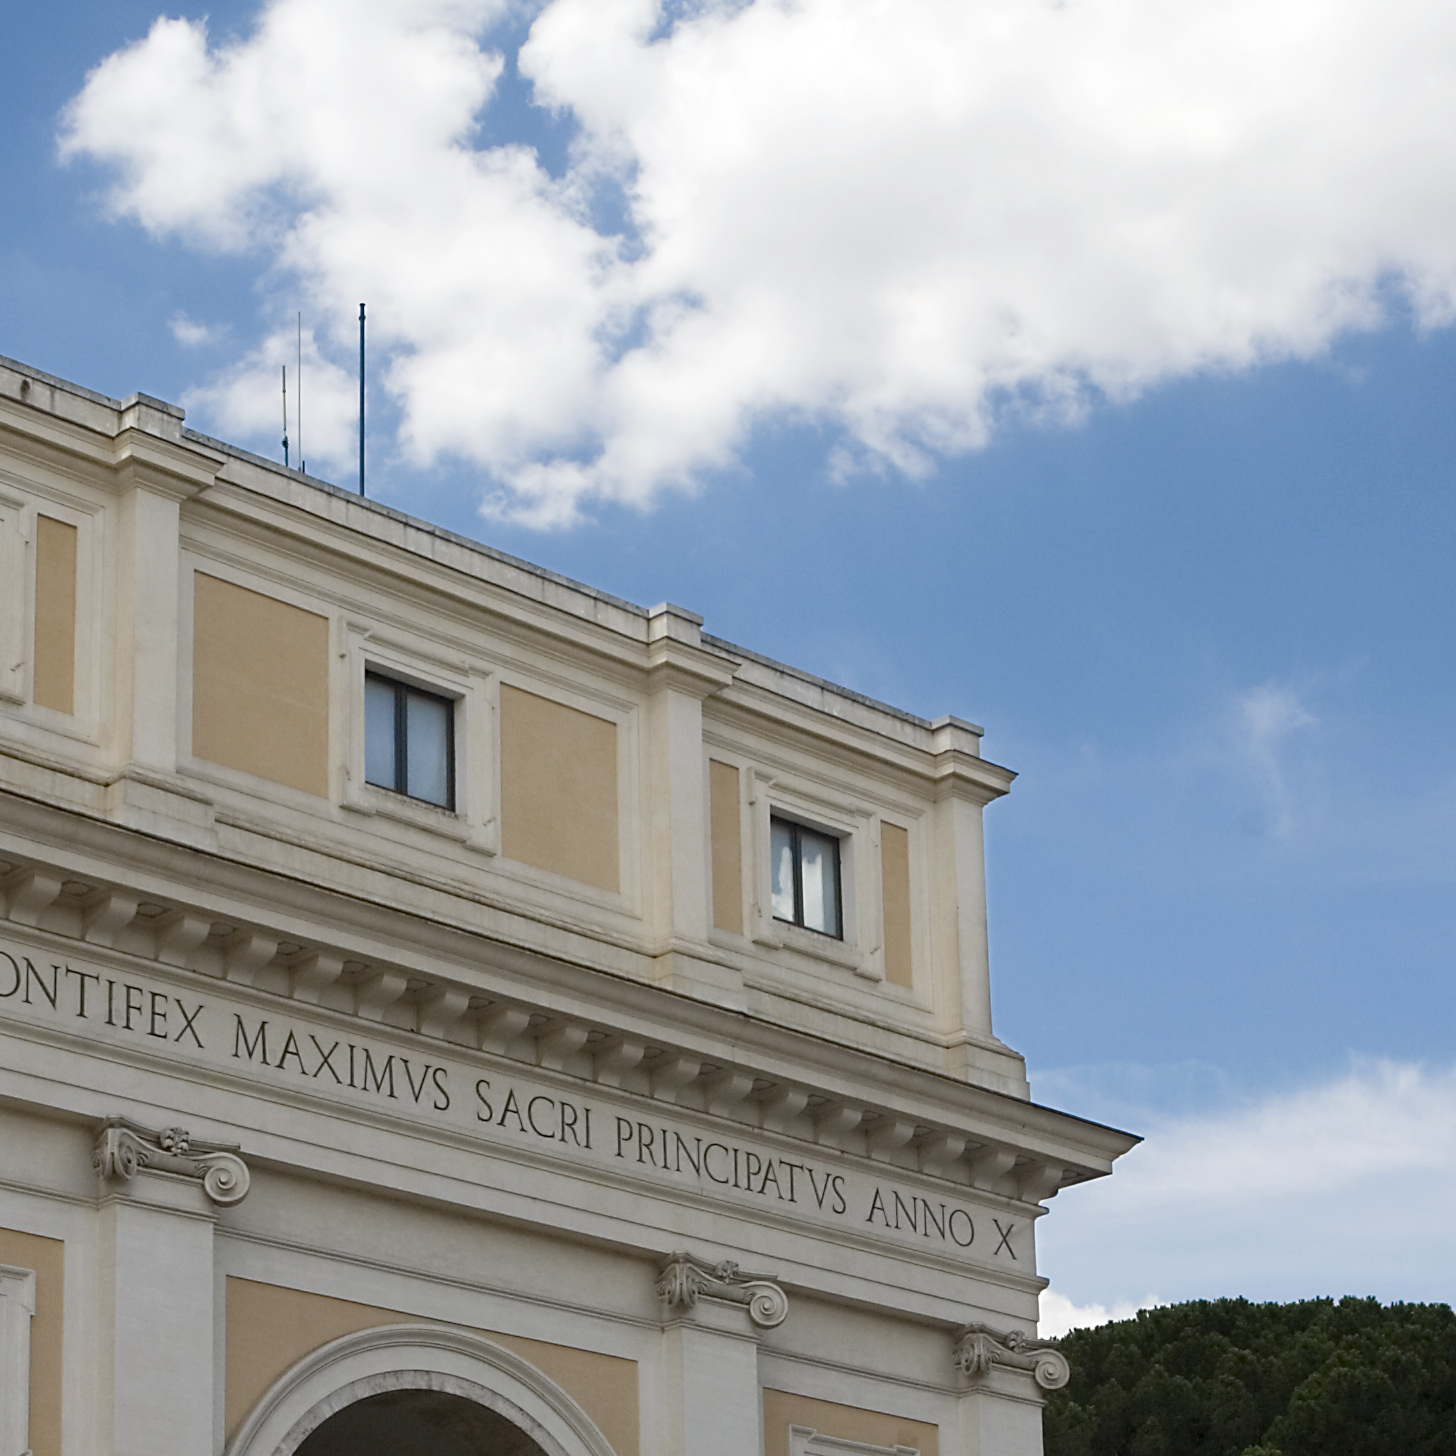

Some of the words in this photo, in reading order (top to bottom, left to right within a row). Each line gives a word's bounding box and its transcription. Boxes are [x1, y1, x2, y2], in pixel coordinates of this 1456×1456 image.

[231, 1012, 451, 1112] MAXIMVS
[474, 1078, 593, 1151] SACRI
[614, 1115, 847, 1214] PRINCIPATVS
[865, 1186, 976, 1248] ANNO
[992, 1218, 1018, 1261] X
